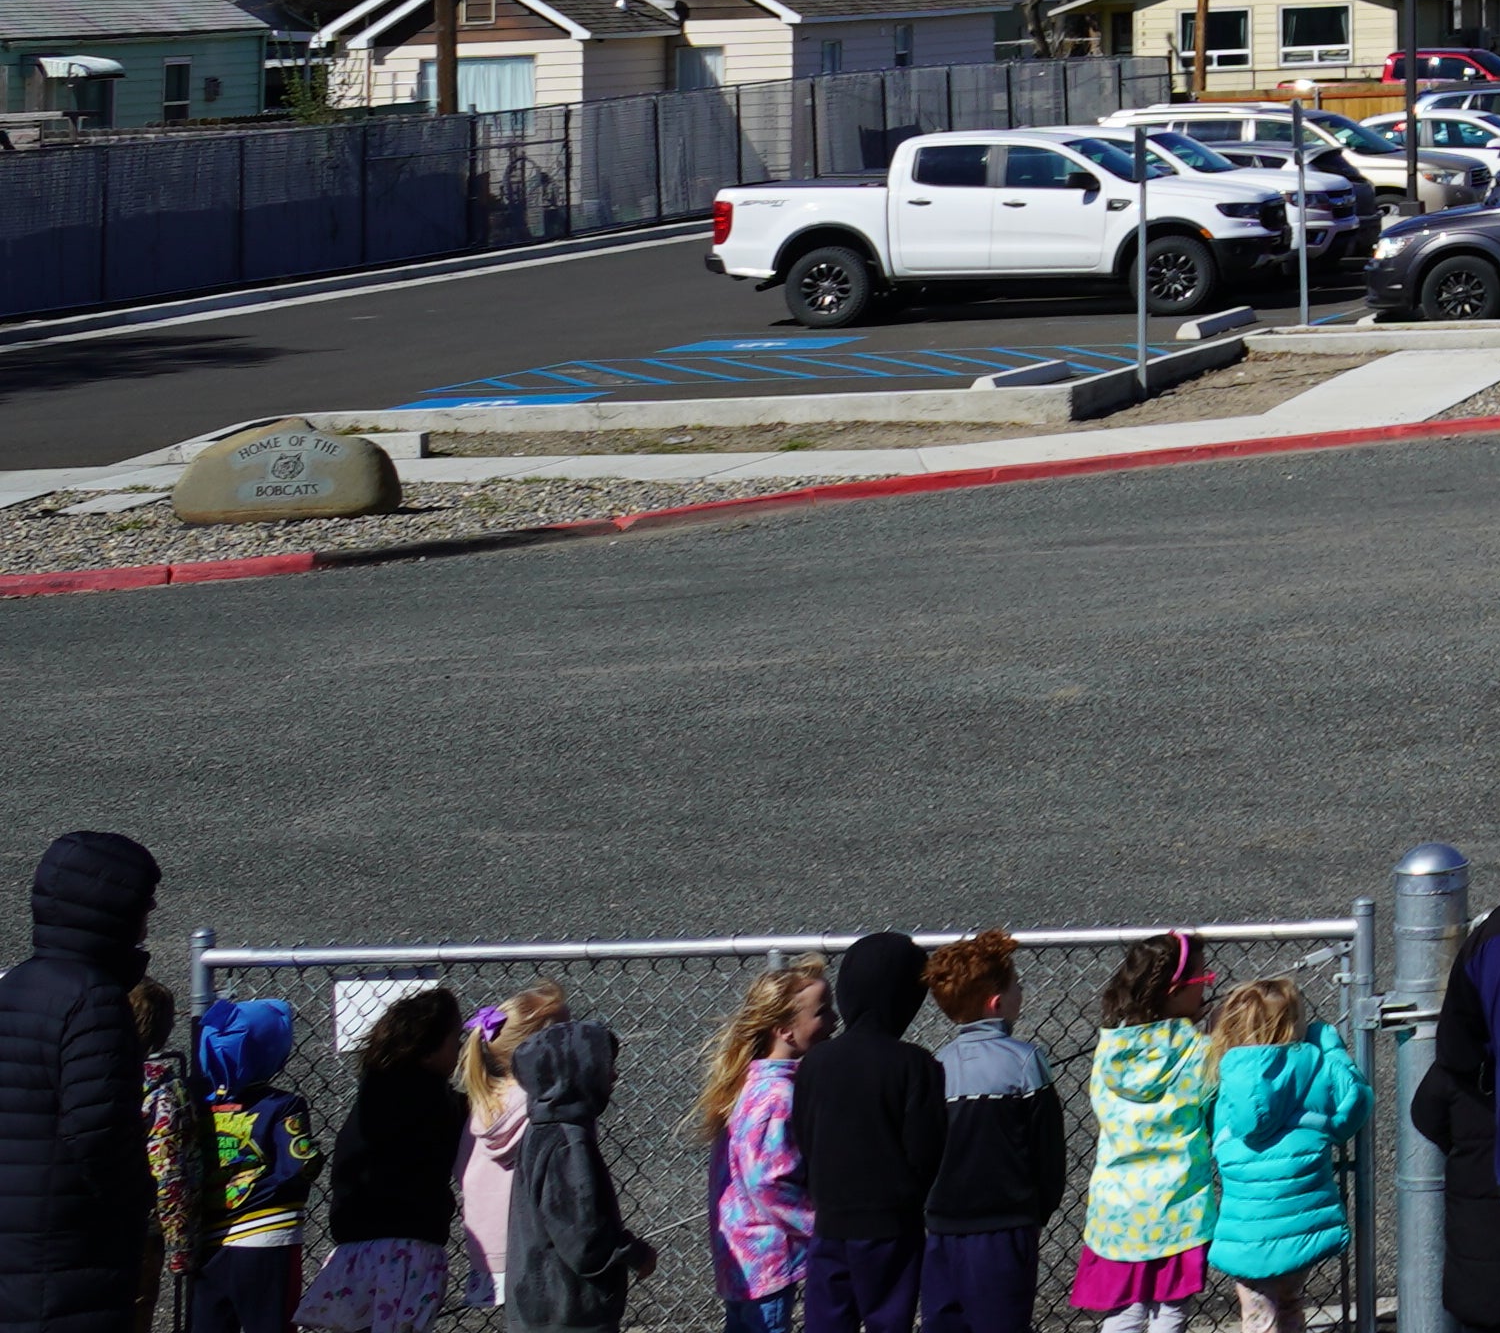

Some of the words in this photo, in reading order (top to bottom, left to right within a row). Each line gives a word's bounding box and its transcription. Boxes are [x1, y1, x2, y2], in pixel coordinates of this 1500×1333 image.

[238, 436, 281, 460] HOME
[288, 435, 308, 447] OF
[314, 438, 341, 457] THE
[255, 483, 319, 497] BOBCATS
